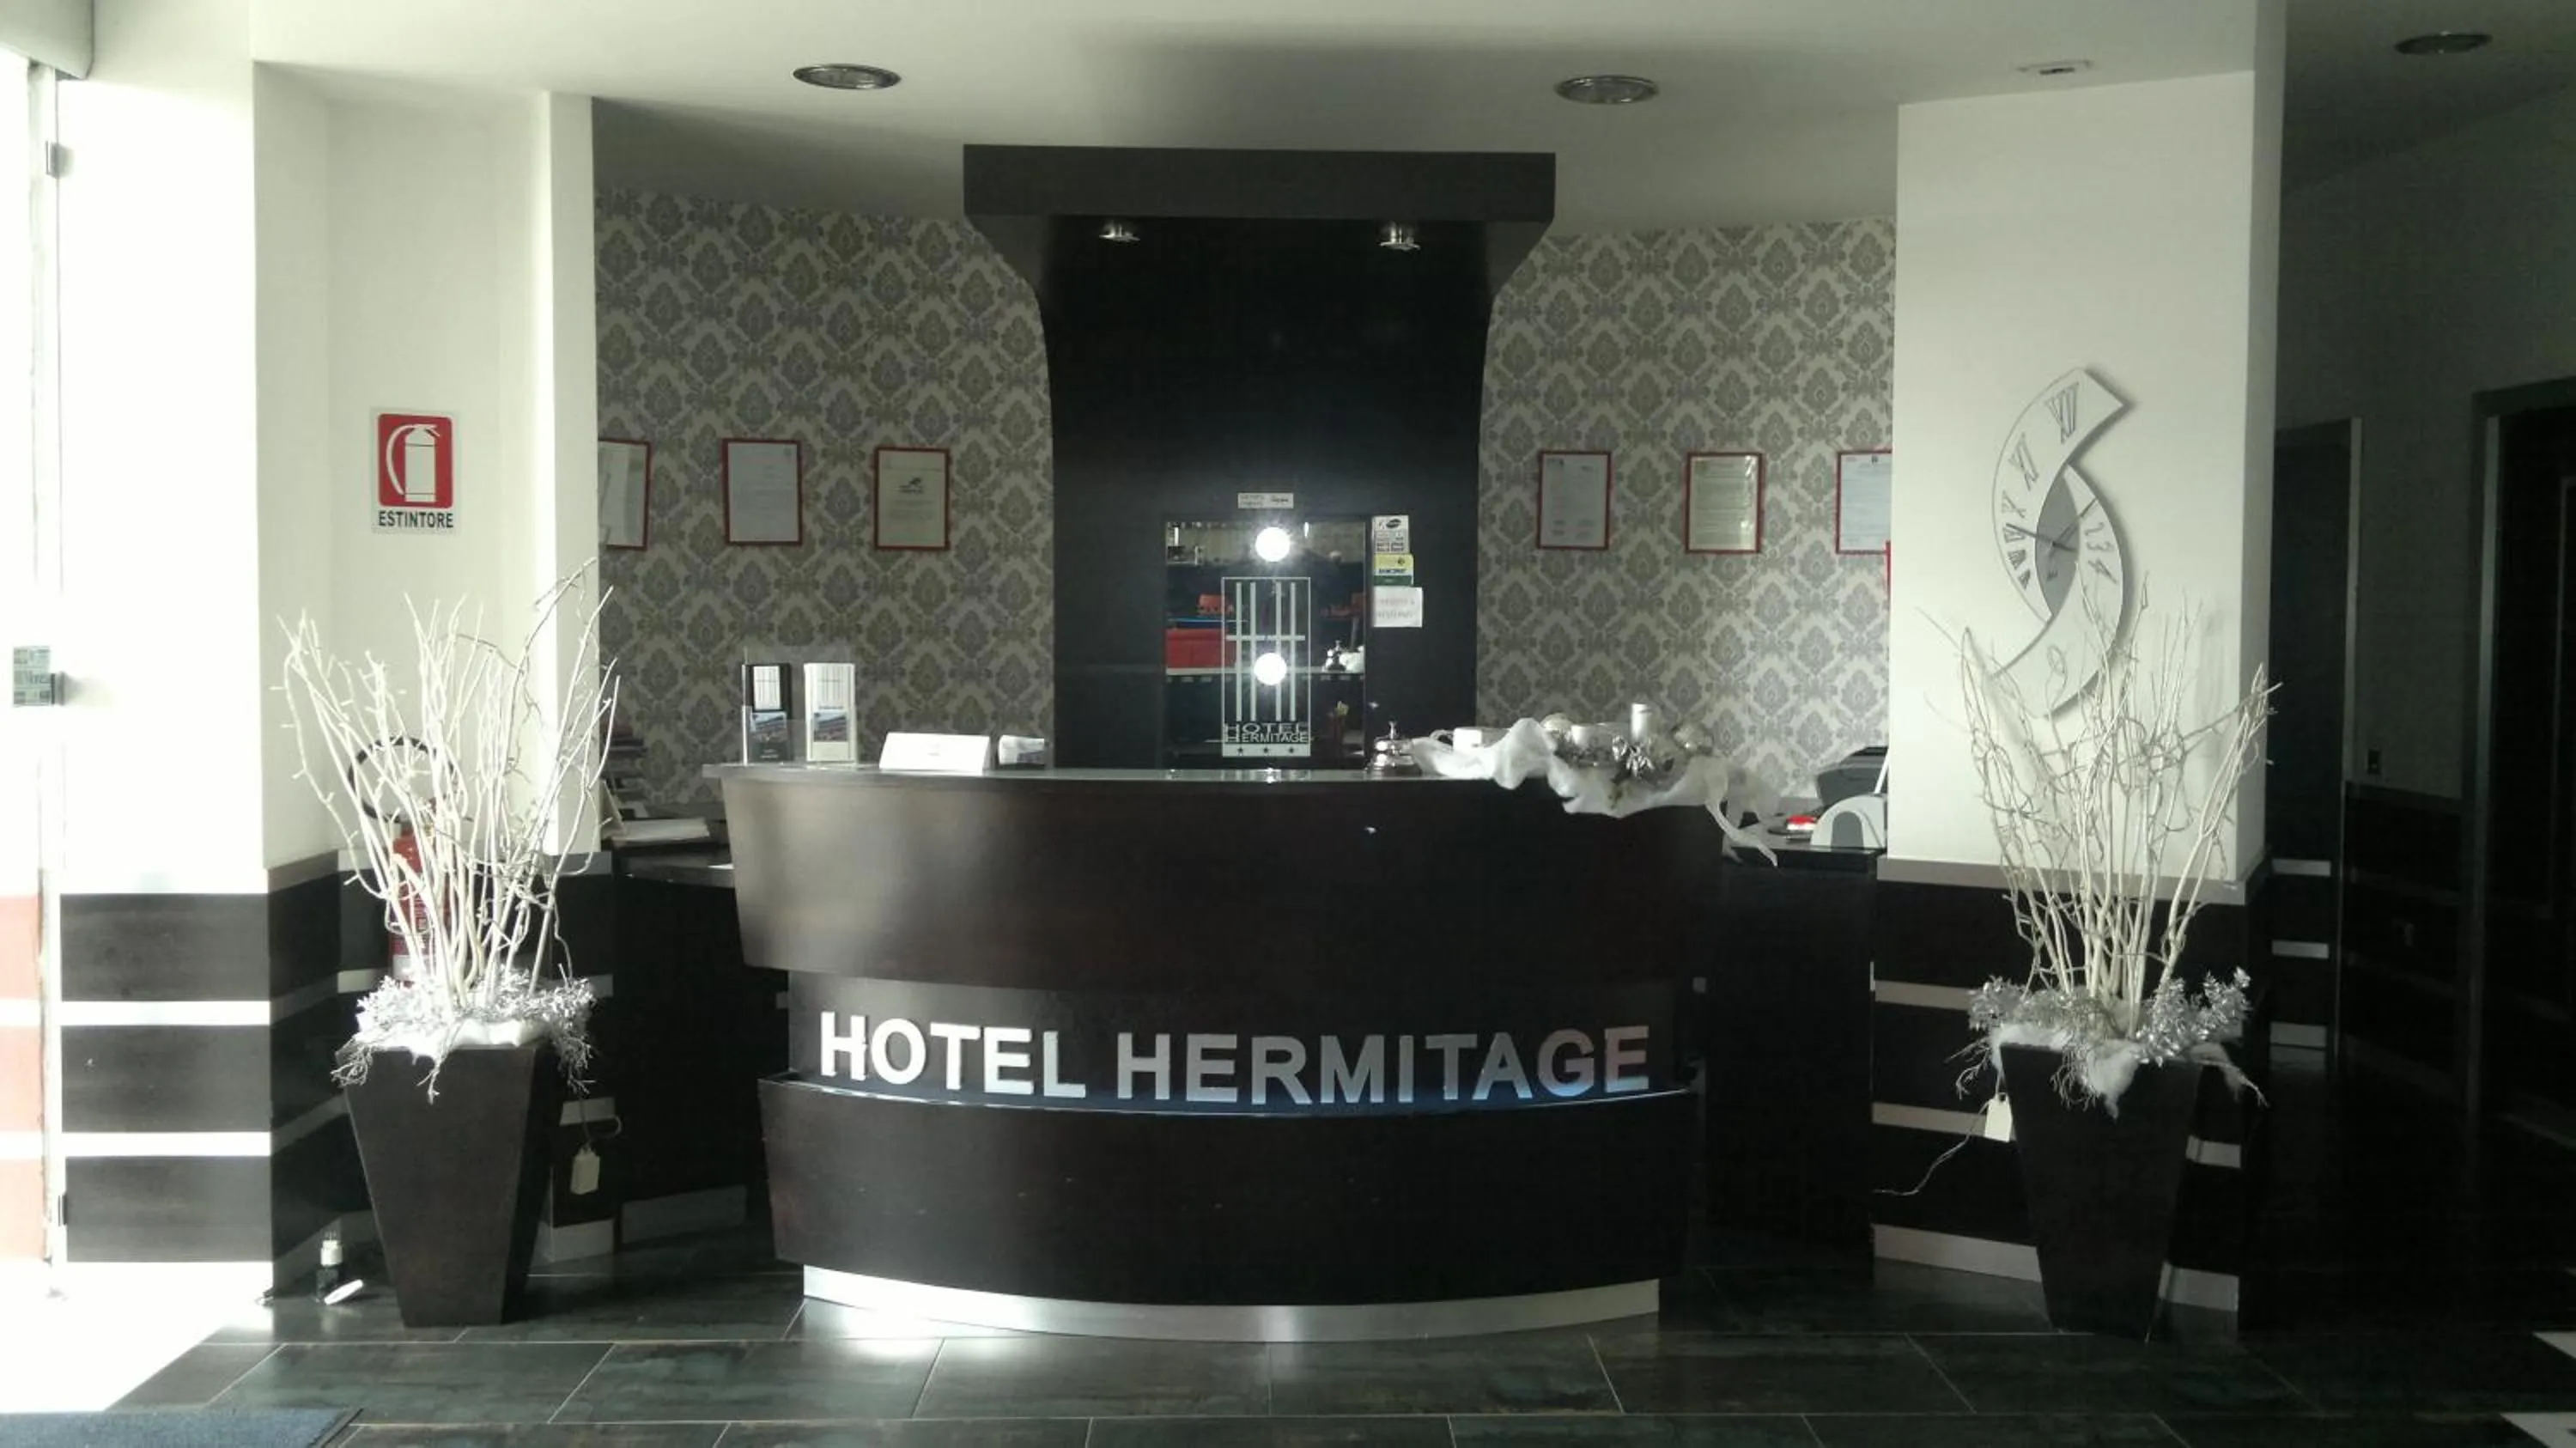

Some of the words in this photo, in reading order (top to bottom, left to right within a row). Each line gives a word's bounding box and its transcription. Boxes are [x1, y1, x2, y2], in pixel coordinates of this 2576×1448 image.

[379, 510, 453, 528] ESTINTORE
[1224, 722, 1308, 734] HOTEL
[821, 1012, 1086, 1098] HOTEL
[1117, 1025, 1649, 1105] HERMITAGE
